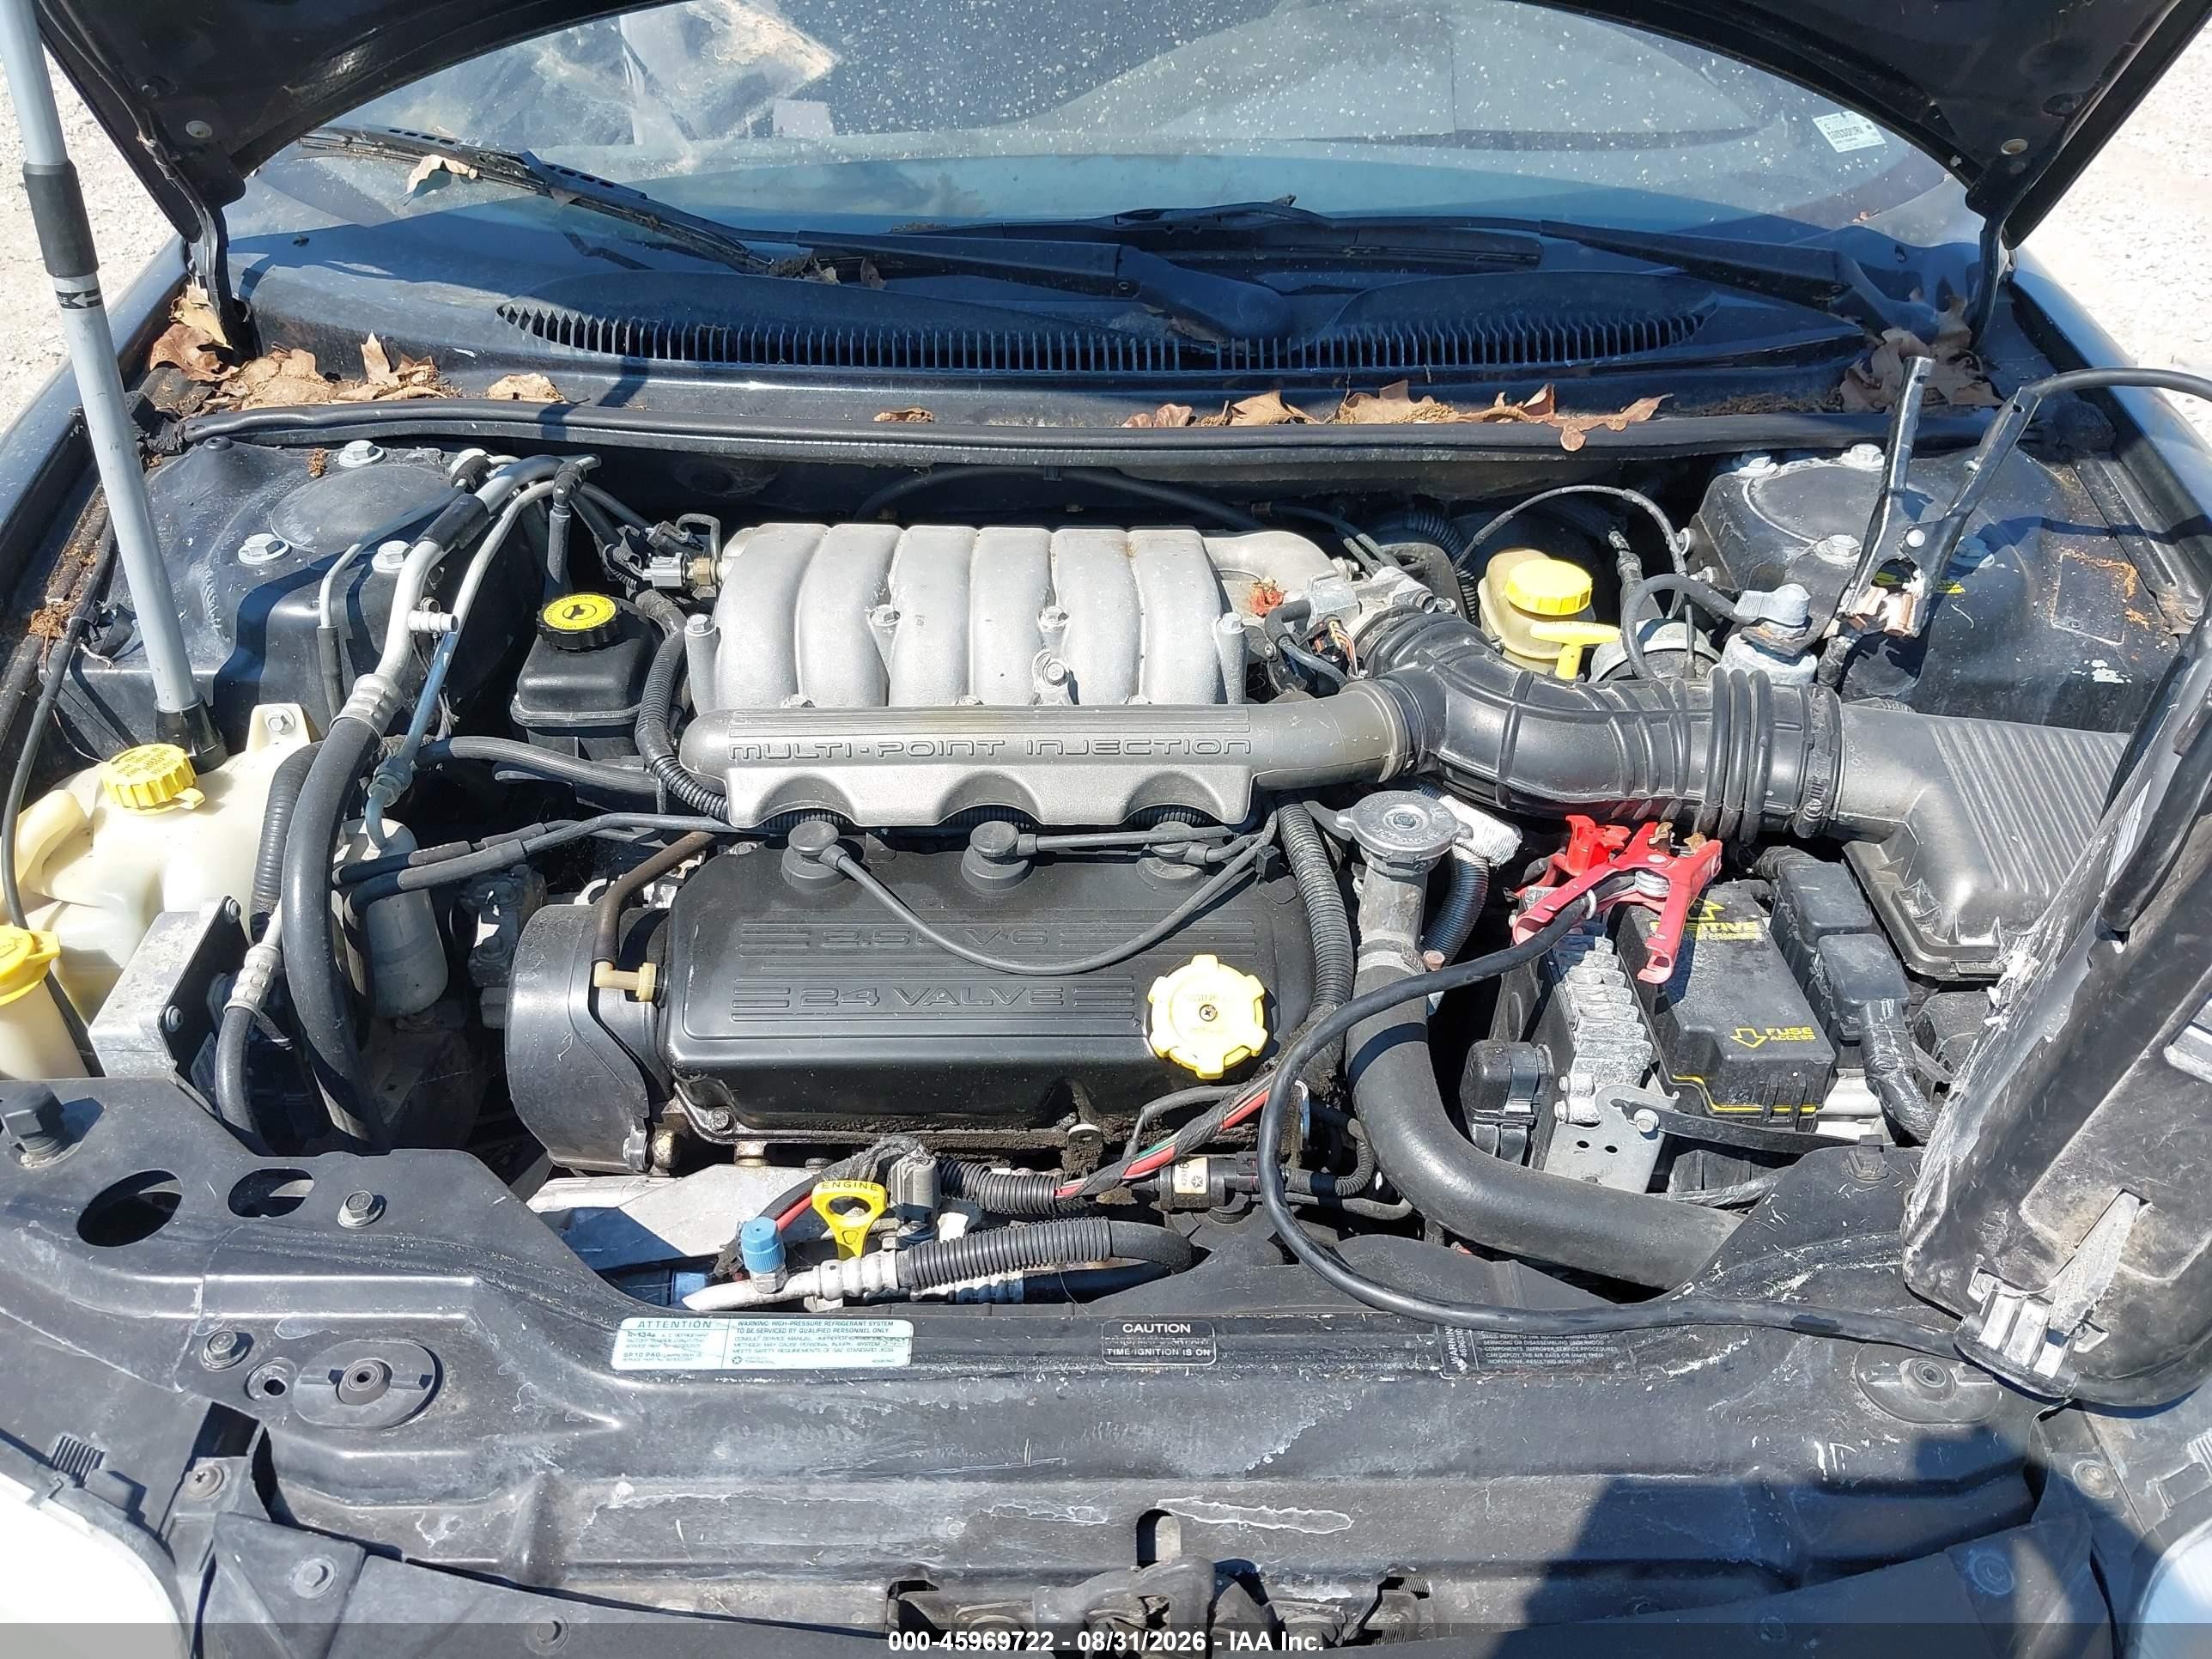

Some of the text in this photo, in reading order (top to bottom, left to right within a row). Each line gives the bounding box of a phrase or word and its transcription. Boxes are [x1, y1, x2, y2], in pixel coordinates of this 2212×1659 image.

[1026, 738, 1251, 756] INJECTION
[800, 987, 1065, 1007] 24 VALVE
[1765, 1026, 1814, 1036] FUSE
[822, 1181, 878, 1191] ENGINE
[636, 1320, 713, 1328] ATTENTION
[1121, 1323, 1191, 1333] CAUTION
